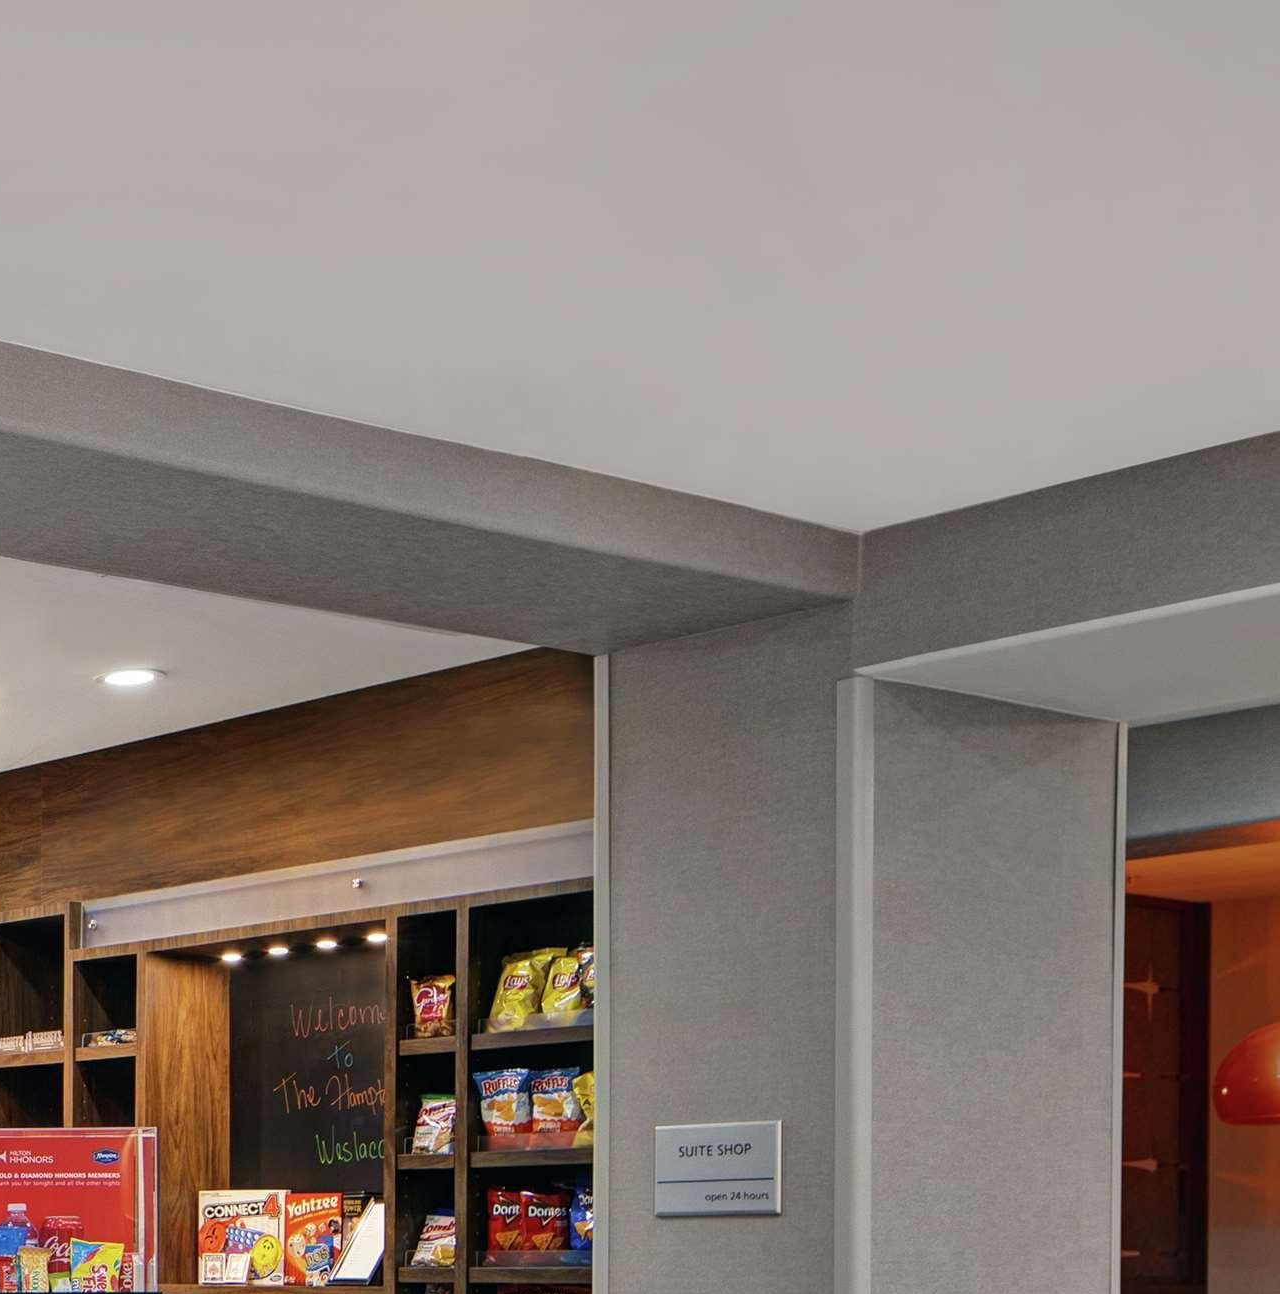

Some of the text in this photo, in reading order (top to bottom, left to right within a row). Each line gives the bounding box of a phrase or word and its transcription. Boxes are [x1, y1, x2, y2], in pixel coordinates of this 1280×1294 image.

[273, 1072, 321, 1114] The
[482, 1076, 520, 1096] RUFFLES
[678, 1143, 752, 1158] SUITE SHOP
[9, 1156, 54, 1164] HHONORS
[705, 1191, 769, 1202] open 24 hours
[204, 1203, 265, 1218] CONNECT
[263, 1193, 280, 1217] 4
[286, 1196, 338, 1217] Yahtzee
[528, 1205, 567, 1217] Doritos
